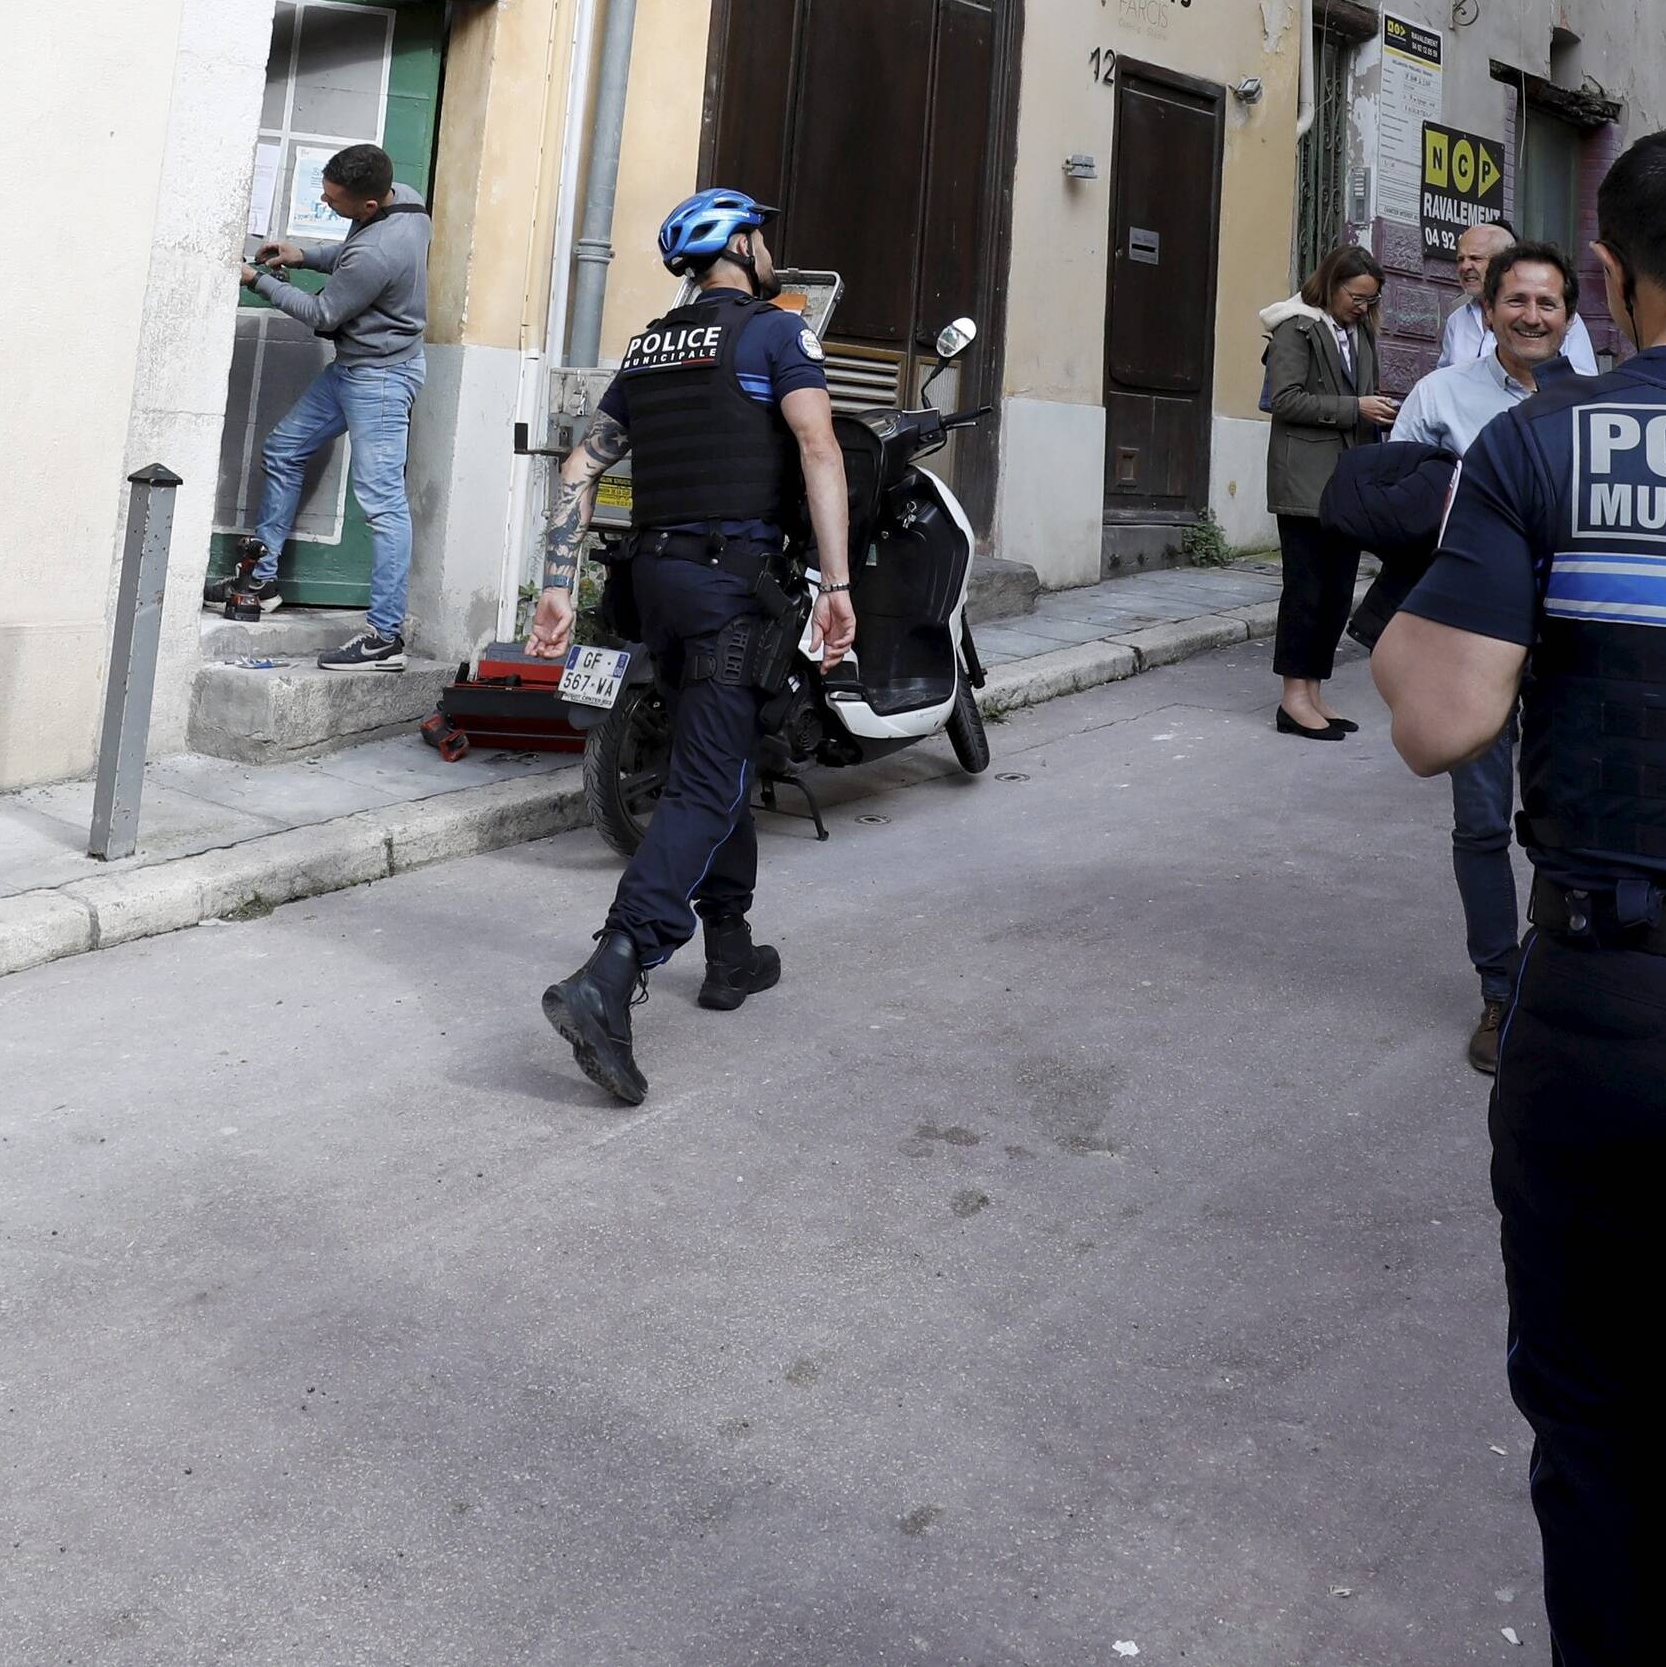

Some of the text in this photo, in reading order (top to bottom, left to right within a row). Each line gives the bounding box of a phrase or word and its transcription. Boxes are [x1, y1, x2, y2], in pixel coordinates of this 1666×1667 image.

[1089, 47, 1116, 84] 12
[1425, 227, 1456, 250] 04 92
[627, 327, 722, 359] POLICE
[623, 348, 717, 368] MUNICIPALE
